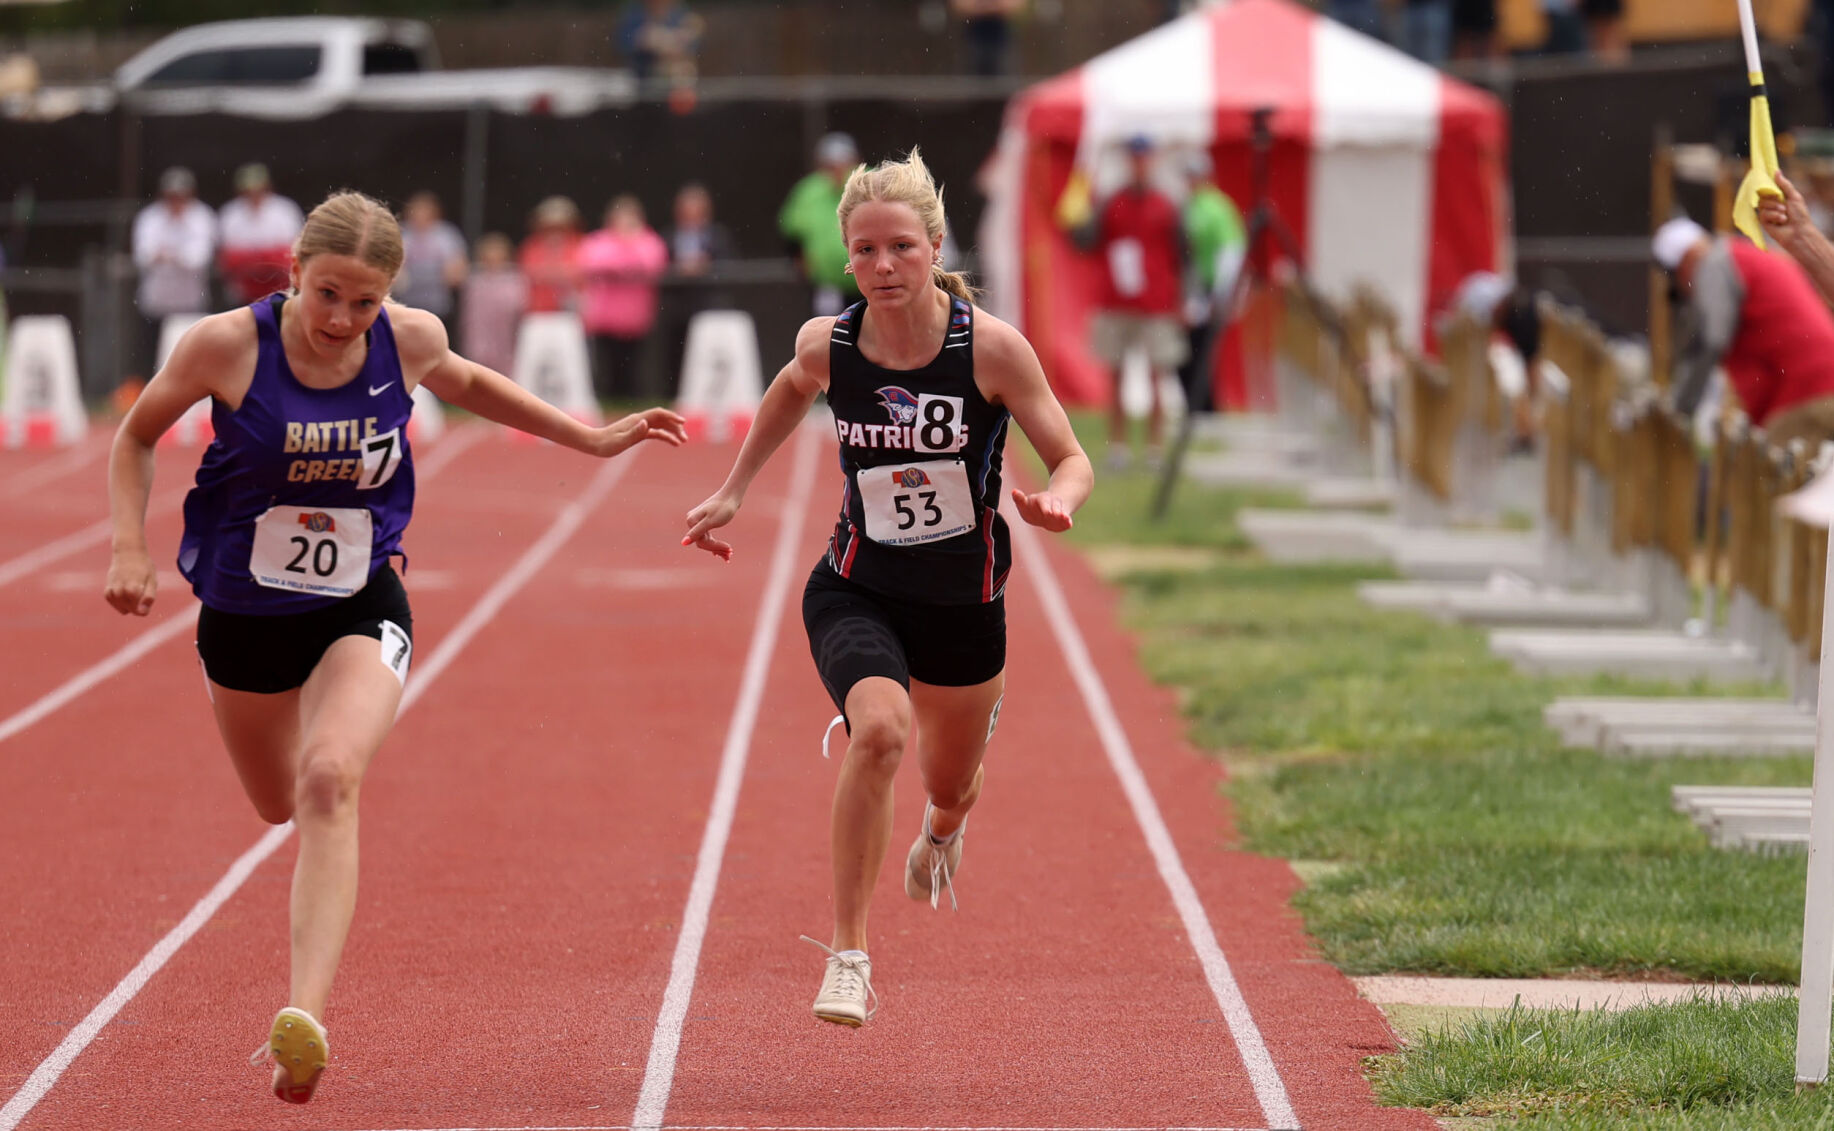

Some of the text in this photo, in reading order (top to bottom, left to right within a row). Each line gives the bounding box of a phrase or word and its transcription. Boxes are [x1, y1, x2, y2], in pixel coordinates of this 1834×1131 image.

[283, 417, 377, 453] BATTLE
[837, 419, 969, 449] PATRIS
[920, 399, 954, 450] 8
[367, 436, 394, 486] 7
[894, 491, 942, 530] 53
[904, 535, 919, 544] FIELD
[921, 524, 967, 541] CHAMPIONSHIPS
[285, 536, 338, 577] 20
